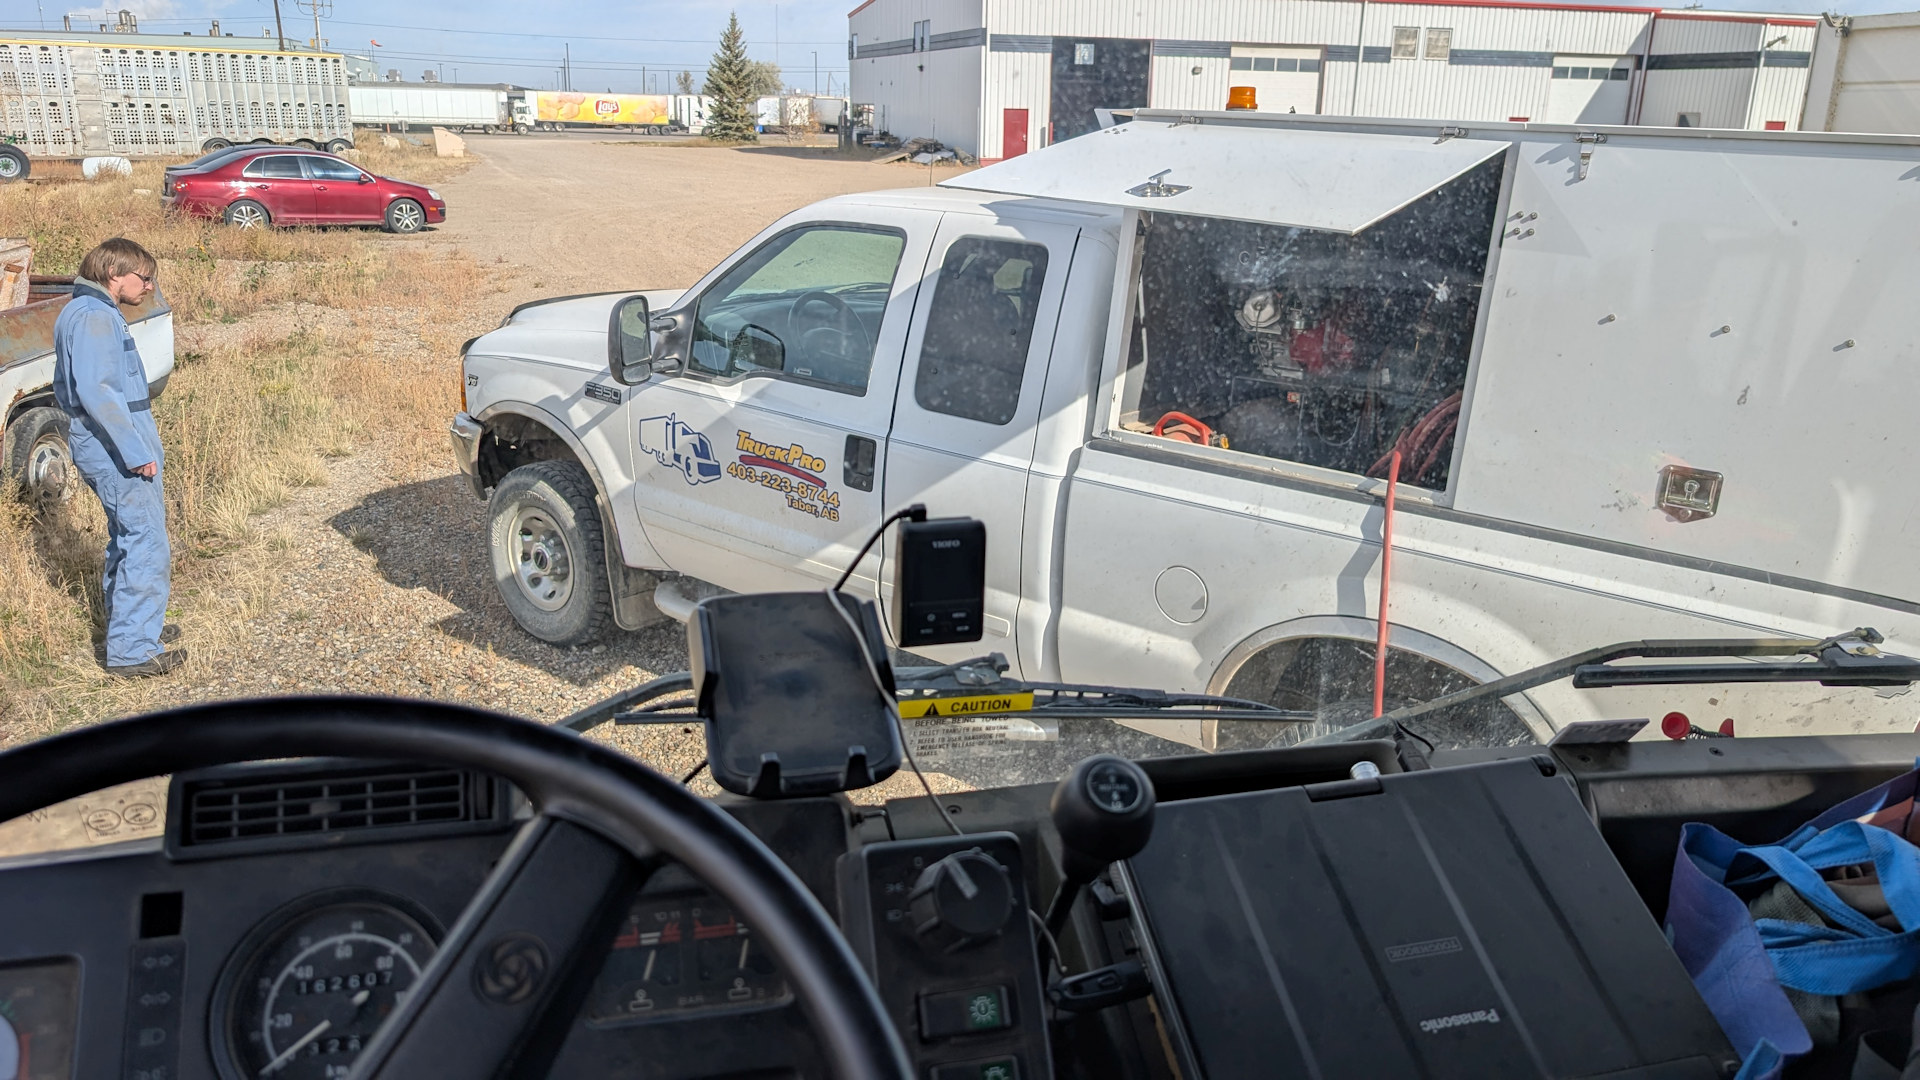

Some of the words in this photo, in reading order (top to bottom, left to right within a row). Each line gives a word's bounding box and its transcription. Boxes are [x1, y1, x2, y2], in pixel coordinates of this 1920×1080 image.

[727, 462, 840, 507] 403-223-8744
[785, 493, 820, 518] Taber,
[821, 506, 840, 522] AB
[951, 699, 1012, 713] CAUTION
[915, 719, 946, 727] BEFORE
[334, 945, 353, 959] 60
[376, 956, 394, 970] 80
[295, 965, 314, 979] 40
[299, 971, 393, 994] 162607
[274, 1013, 293, 1028] 20
[1419, 1008, 1500, 1034] Panasonic
